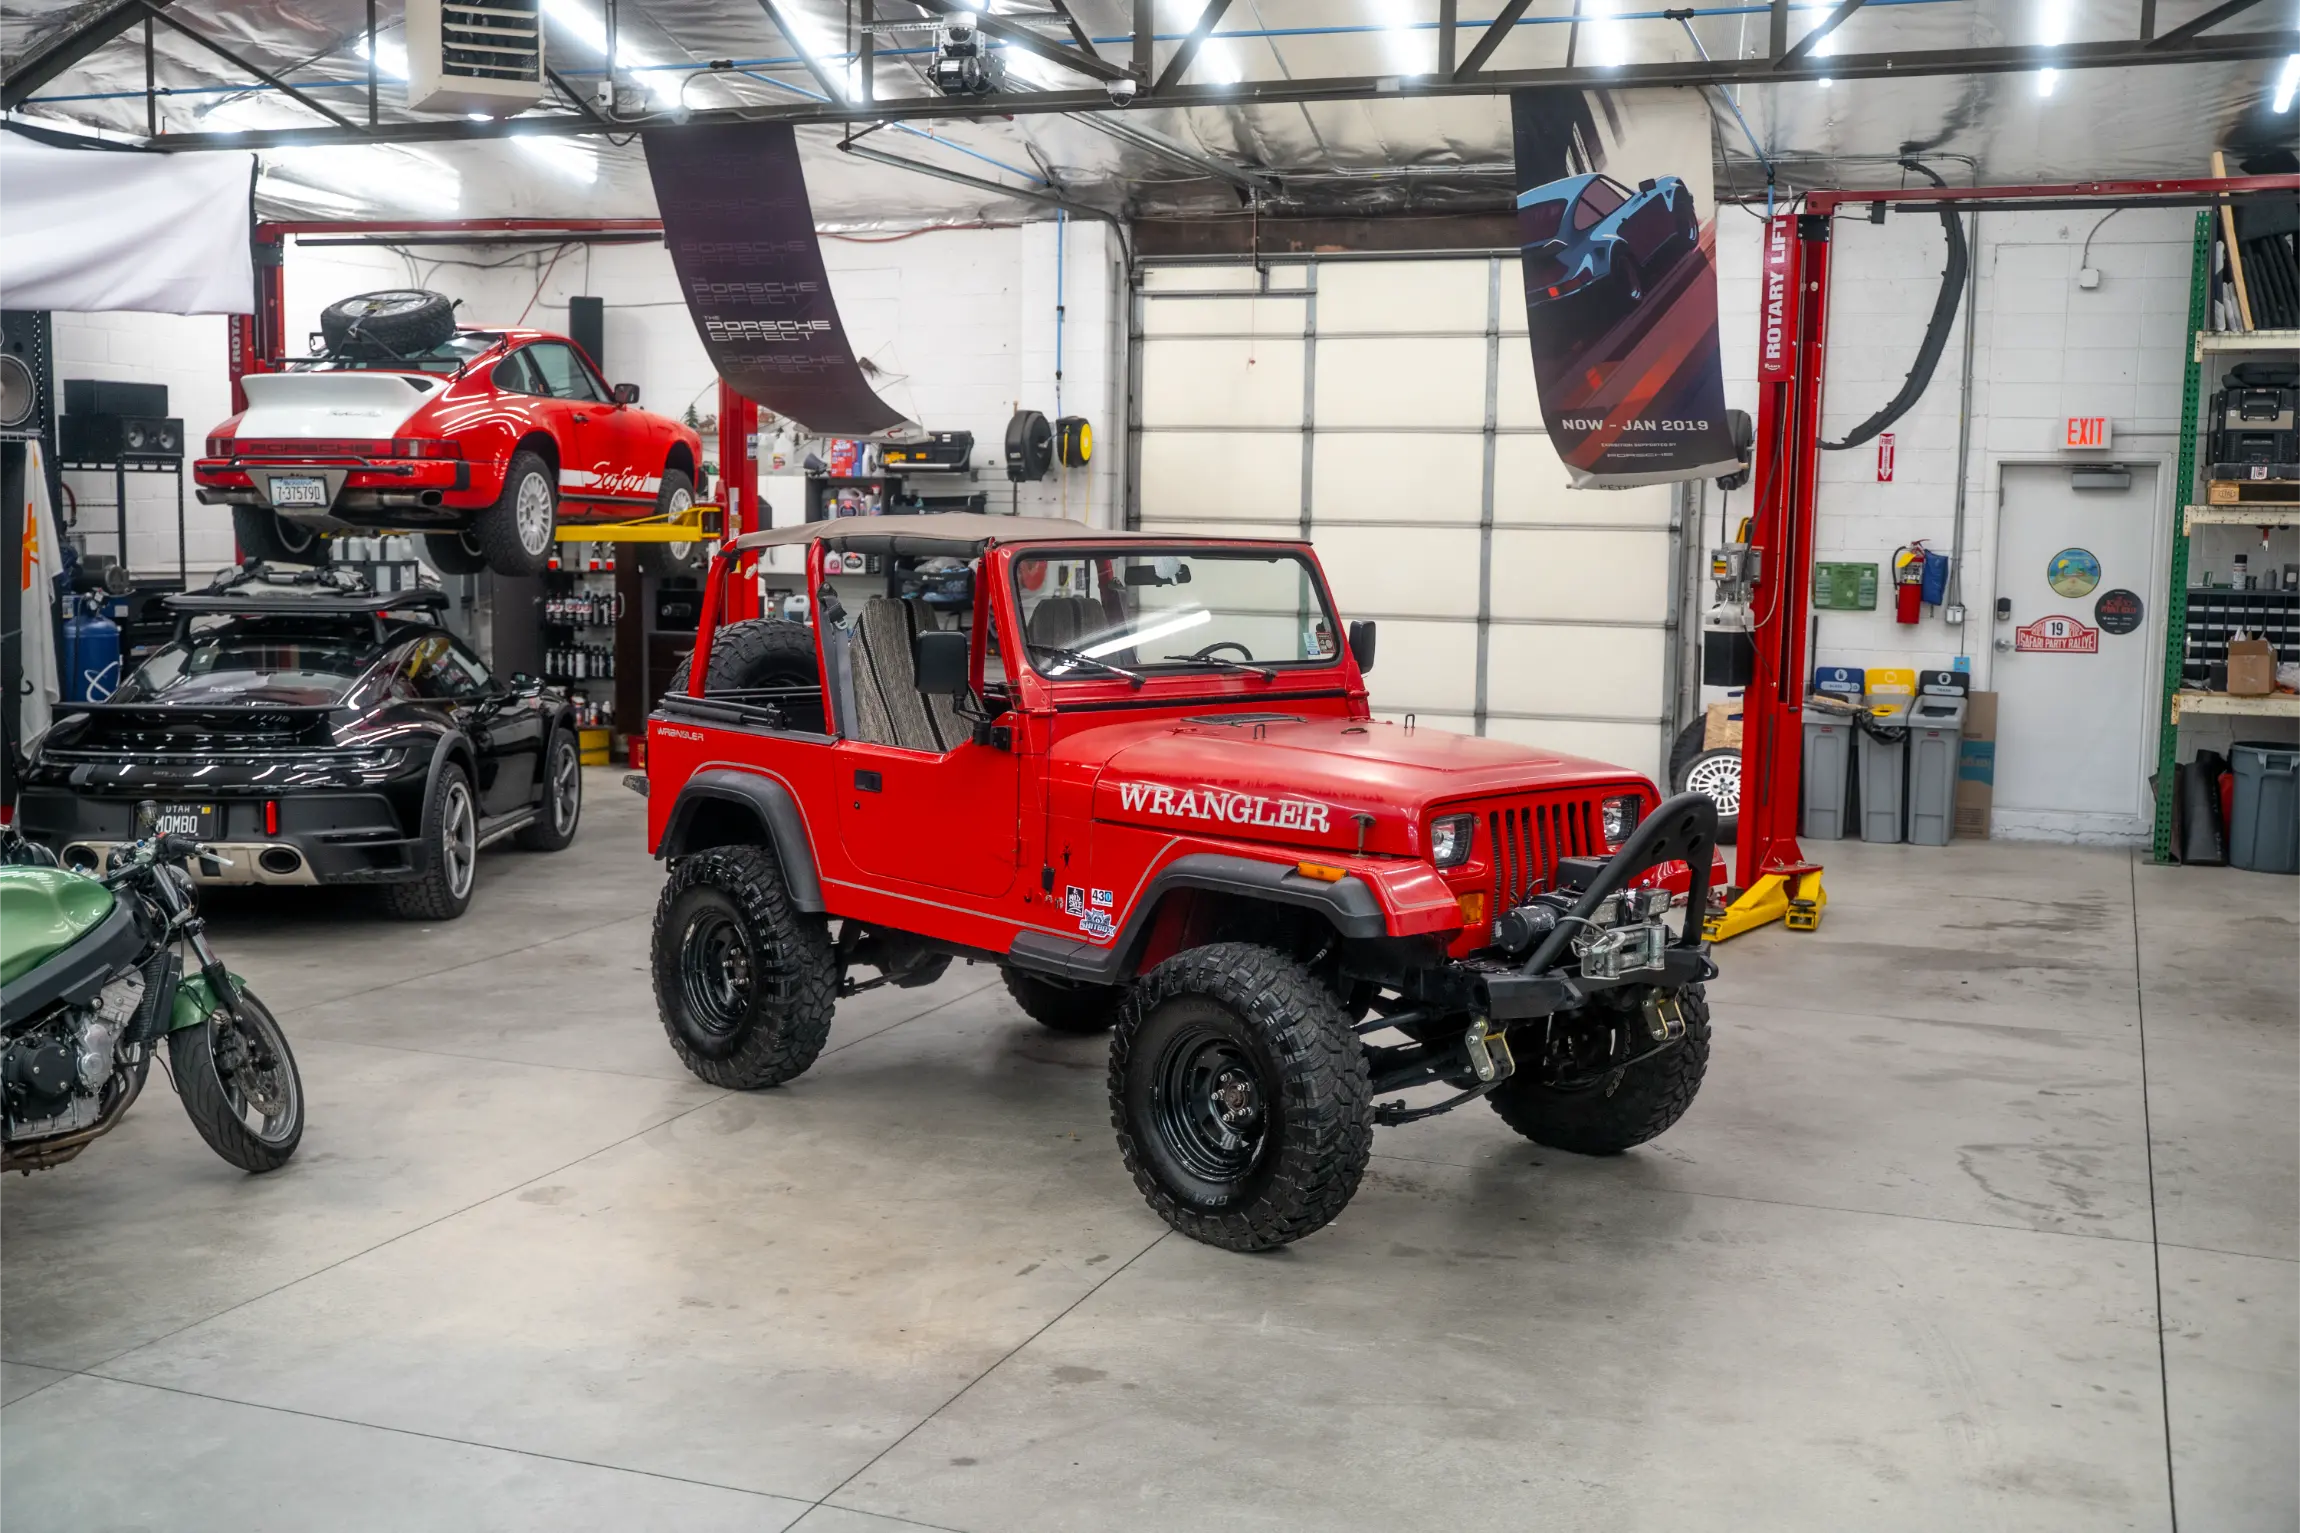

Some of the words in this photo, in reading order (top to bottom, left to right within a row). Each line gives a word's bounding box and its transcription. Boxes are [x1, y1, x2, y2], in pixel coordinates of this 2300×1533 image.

[681, 240, 808, 254] PORSCHE
[1771, 218, 1787, 264] LIFT
[692, 281, 819, 294] PORSCHE
[696, 294, 804, 305] EFFECT
[1765, 271, 1784, 359] ROTARY
[705, 320, 832, 332] PORSCHE
[709, 331, 815, 342] EFFECT
[722, 355, 845, 365] PORSCHE
[1562, 419, 1604, 431] NOW
[1622, 420, 1656, 431] JAN
[1661, 420, 1710, 432] 2019
[2067, 417, 2106, 446] EXIT
[250, 443, 373, 453] PORSCHE
[591, 461, 651, 496] Safari
[2051, 622, 2064, 636] 19
[2020, 632, 2044, 648] SAFARI
[2044, 637, 2067, 649] PARTY
[2068, 634, 2094, 649] RALLYE
[656, 727, 705, 742] WRANGLER
[165, 804, 191, 813] UTAH
[1119, 782, 1331, 834] WRANGLER
[156, 815, 198, 834] MOMBO
[1092, 889, 1112, 903] 430
[1081, 920, 1115, 936] SHITBOX
